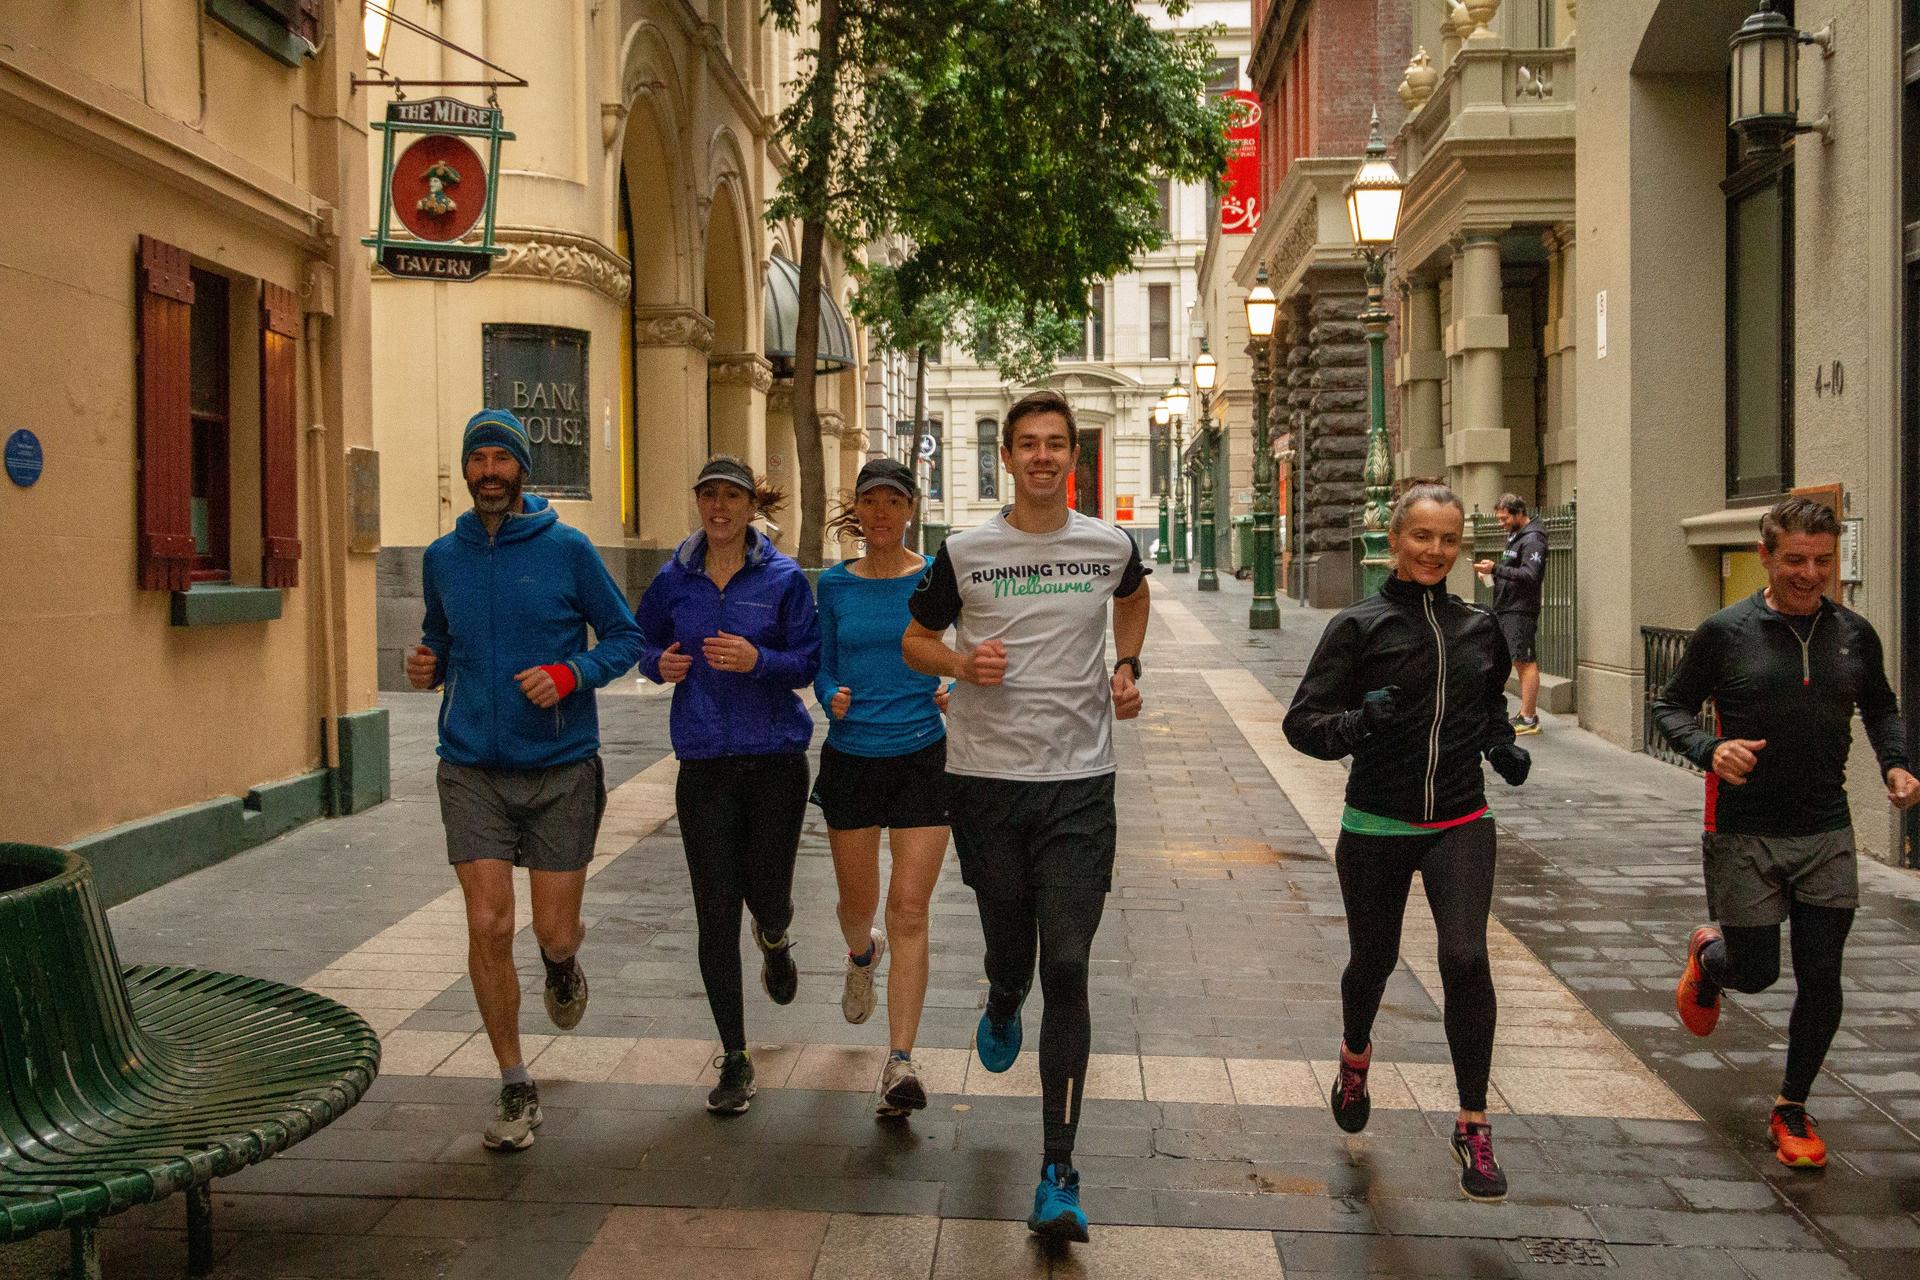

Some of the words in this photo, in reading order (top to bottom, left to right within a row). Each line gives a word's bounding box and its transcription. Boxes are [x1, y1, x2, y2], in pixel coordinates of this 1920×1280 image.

[399, 103, 431, 121] THE
[434, 101, 490, 126] MITRE
[396, 254, 472, 276] TAVERN
[512, 381, 580, 412] BANK
[971, 564, 1053, 584] RUNNING
[1056, 563, 1111, 577] TOURS
[992, 575, 1094, 598] Melbourne
